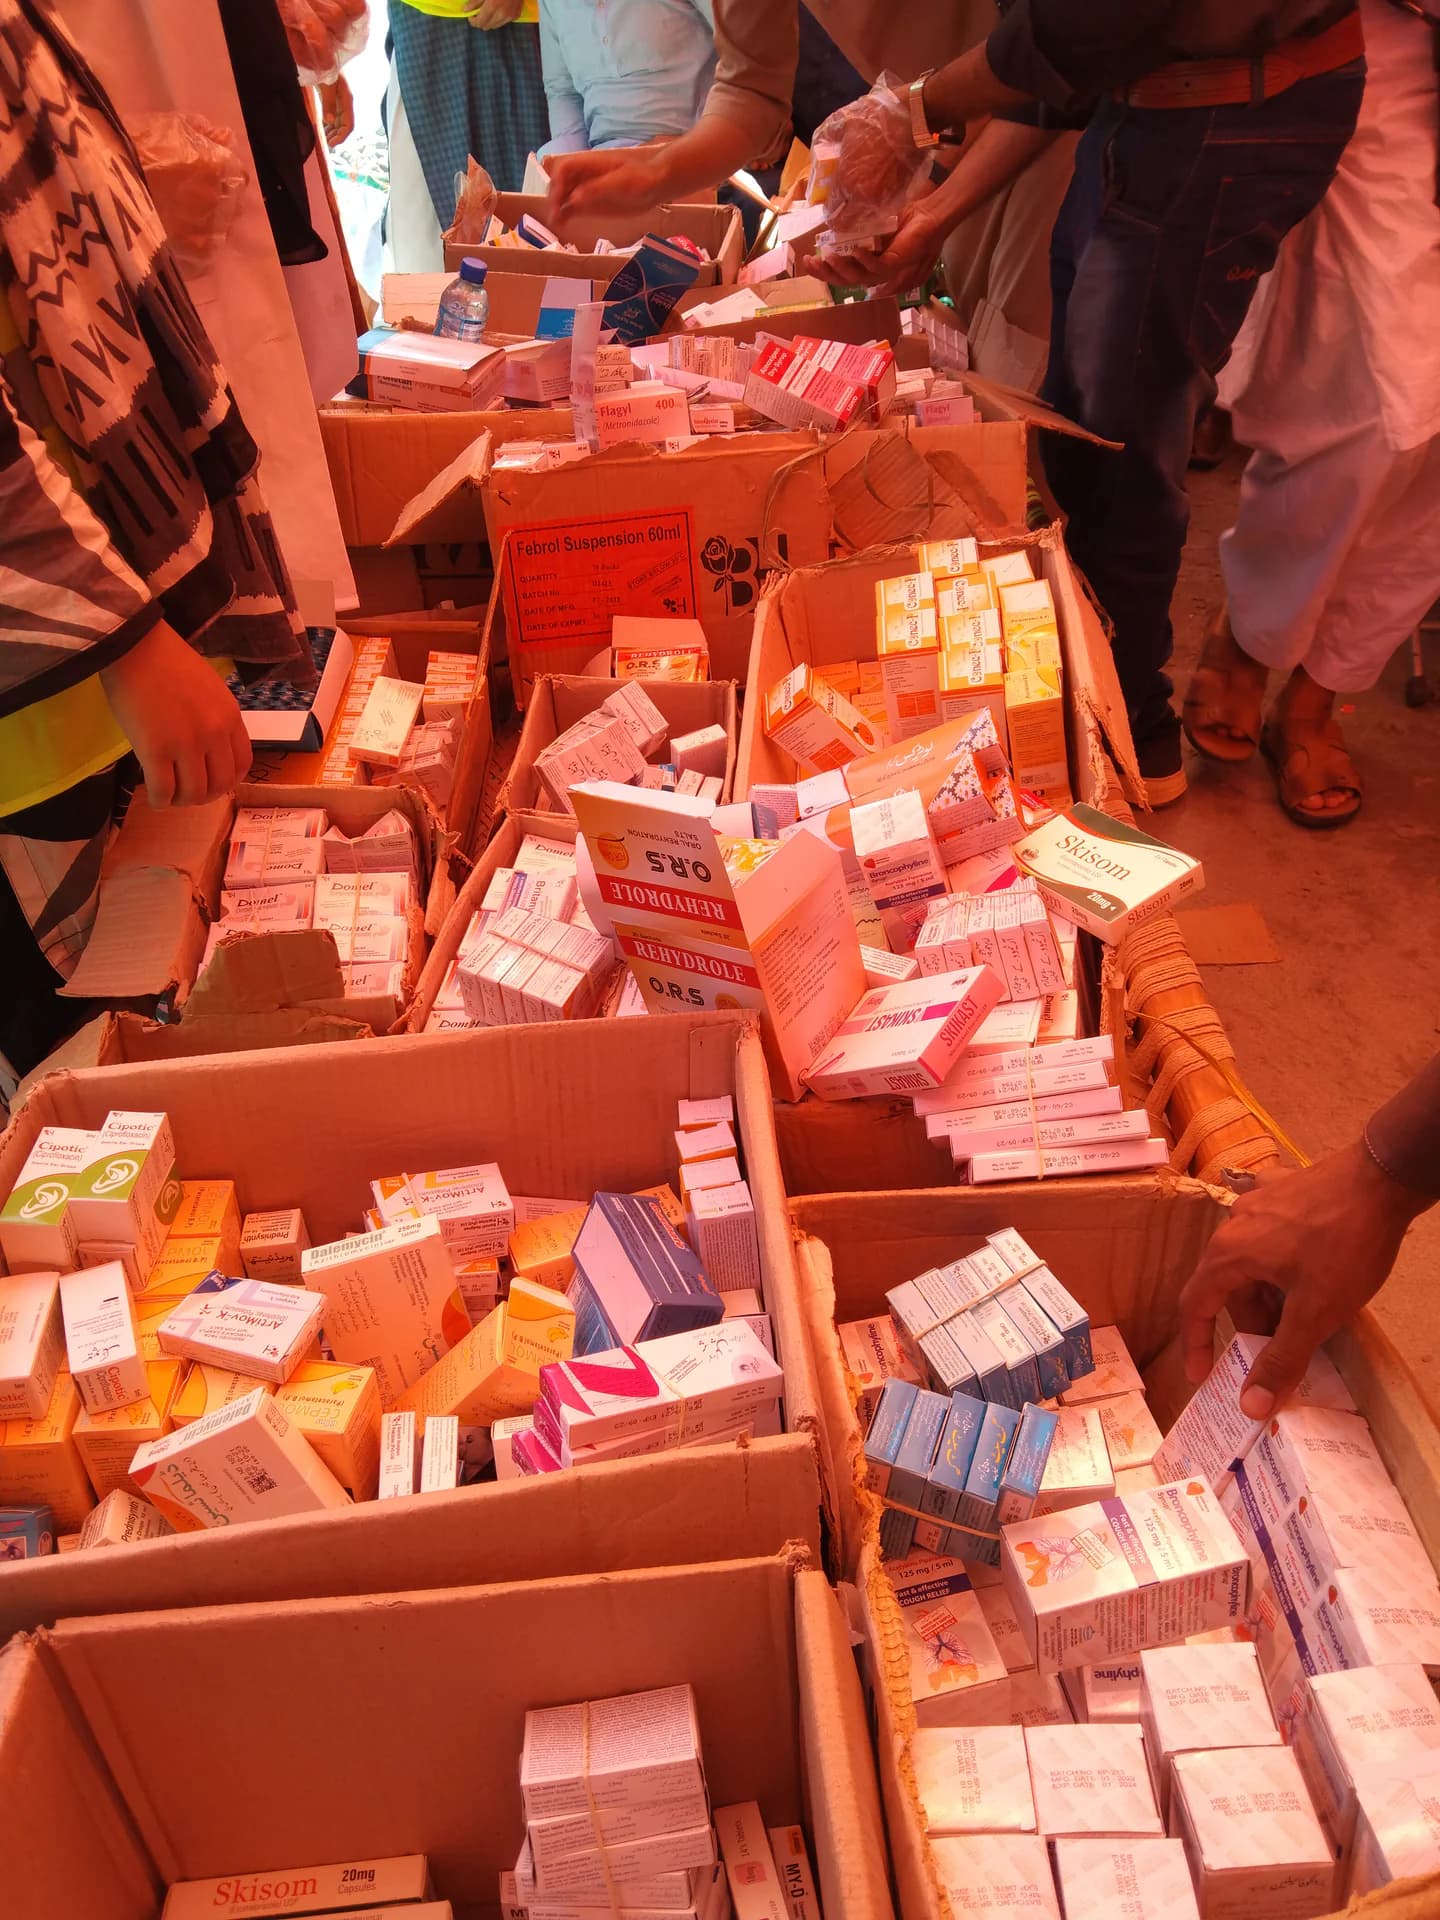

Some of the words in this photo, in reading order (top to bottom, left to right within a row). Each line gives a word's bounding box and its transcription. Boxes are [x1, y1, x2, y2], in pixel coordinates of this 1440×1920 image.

[600, 403, 632, 418] Flagyl
[602, 416, 660, 432] (Metronidazole)
[516, 540, 560, 558] Febrol
[564, 530, 644, 552] Suspension
[648, 523, 681, 542] 60ml
[520, 572, 558, 584] QUANTITY
[524, 606, 542, 617] DATE
[544, 605, 555, 614] OF
[526, 622, 546, 632] DATE
[548, 621, 558, 630] OF
[646, 850, 712, 882] O.R.S
[868, 856, 930, 879] Broncophyline
[1056, 834, 1132, 882] Skisom
[610, 881, 727, 922] REHYDROLE
[1086, 890, 1112, 912] 20mg
[1127, 891, 1171, 926] Skisom
[633, 940, 746, 984] REHYDROLE
[648, 976, 705, 1006] O.R.S
[940, 995, 979, 1048] SKIKAST
[107, 1121, 154, 1134] Cipotic
[38, 1141, 87, 1155] Cipotic
[422, 1186, 486, 1205] ArtiMov-K
[243, 1230, 290, 1245] Prednisynth
[309, 1231, 384, 1262] Dalemycin
[217, 1312, 283, 1326] ArtiMov-K
[868, 1322, 889, 1380] Broncophyline
[108, 1364, 127, 1400] Cipotic
[1110, 1516, 1125, 1540] COUGH
[1120, 1513, 1132, 1528] Fast
[1144, 1518, 1156, 1531] 125
[1166, 1488, 1210, 1562] Broncophyline
[900, 1568, 914, 1579] 125
[918, 1580, 950, 1594] effective
[899, 1596, 926, 1608] COUGH
[926, 1588, 951, 1601] RELIEF
[212, 1876, 317, 1906] Skisom
[342, 1868, 376, 1882] 20mg
[338, 1881, 376, 1894] Capsules
